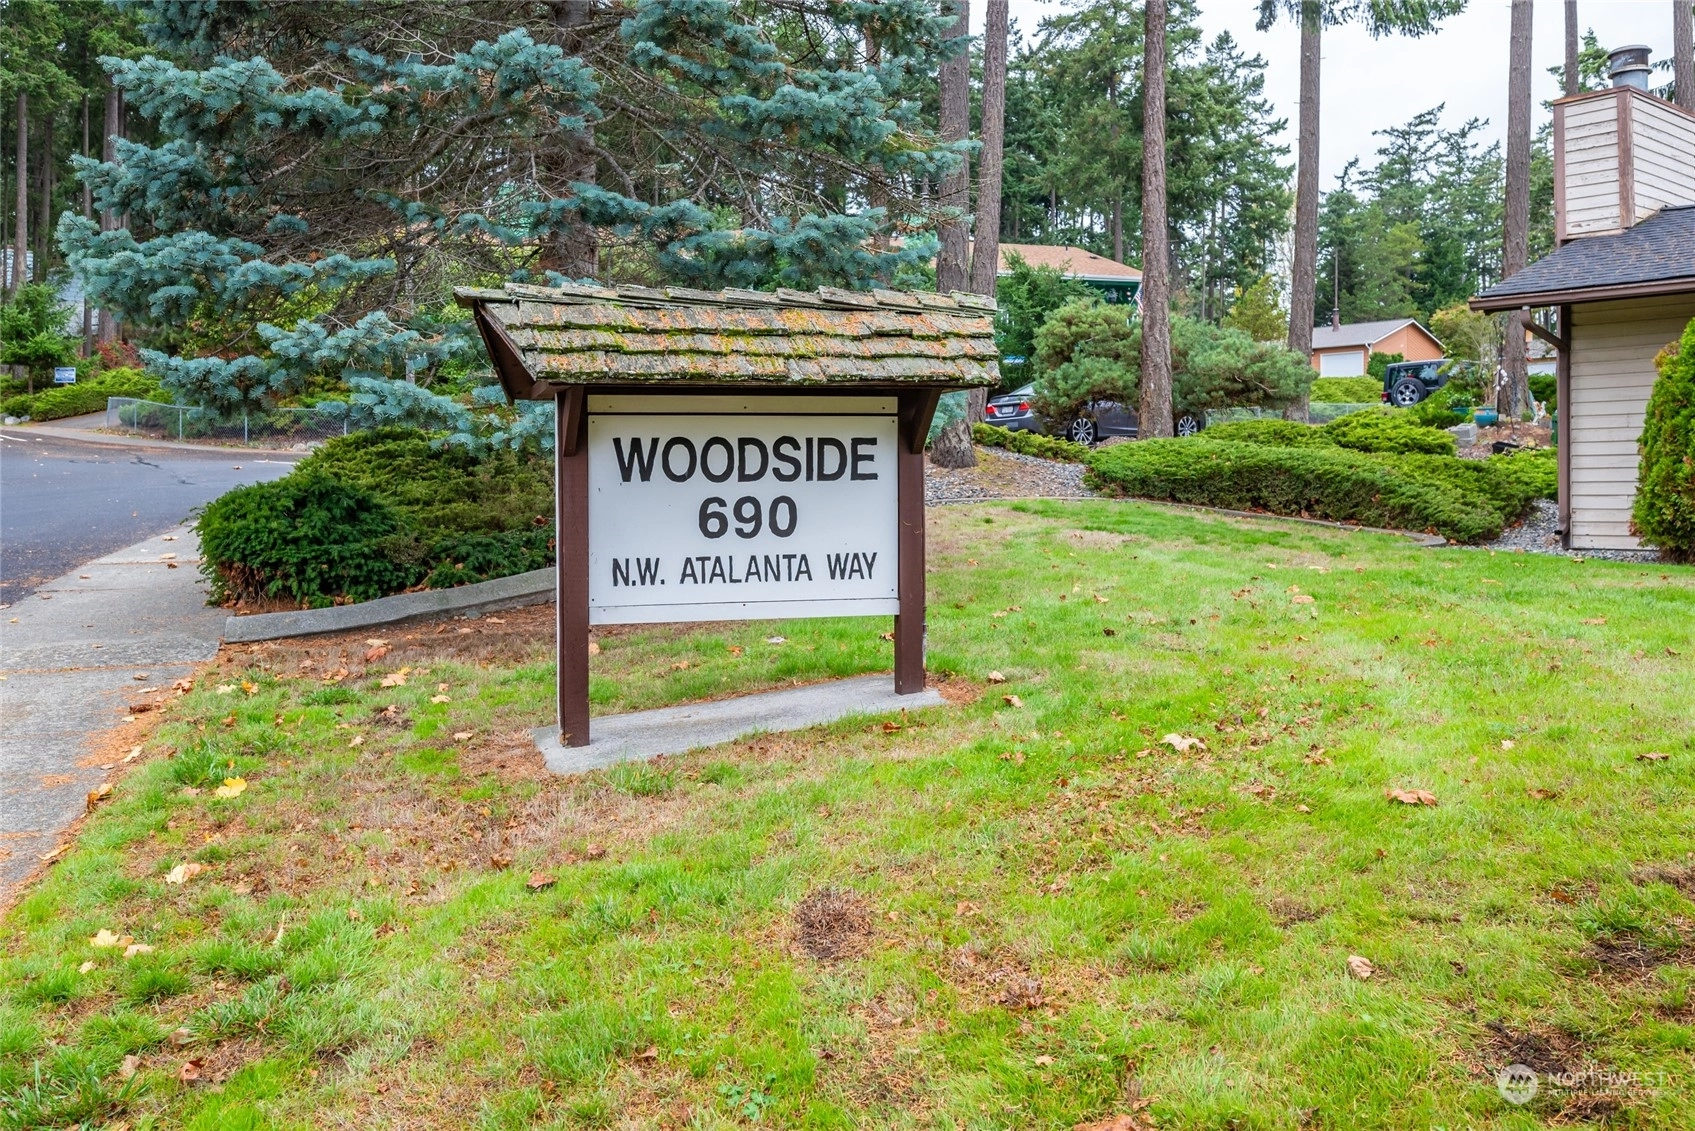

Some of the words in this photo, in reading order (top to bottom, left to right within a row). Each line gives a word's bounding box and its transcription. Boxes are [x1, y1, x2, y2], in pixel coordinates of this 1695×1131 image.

[612, 435, 879, 483] WOODSIDE
[698, 495, 798, 539] 690
[612, 557, 666, 587] N.W.
[679, 553, 814, 585] ATALANTA
[826, 552, 878, 580] WAY
